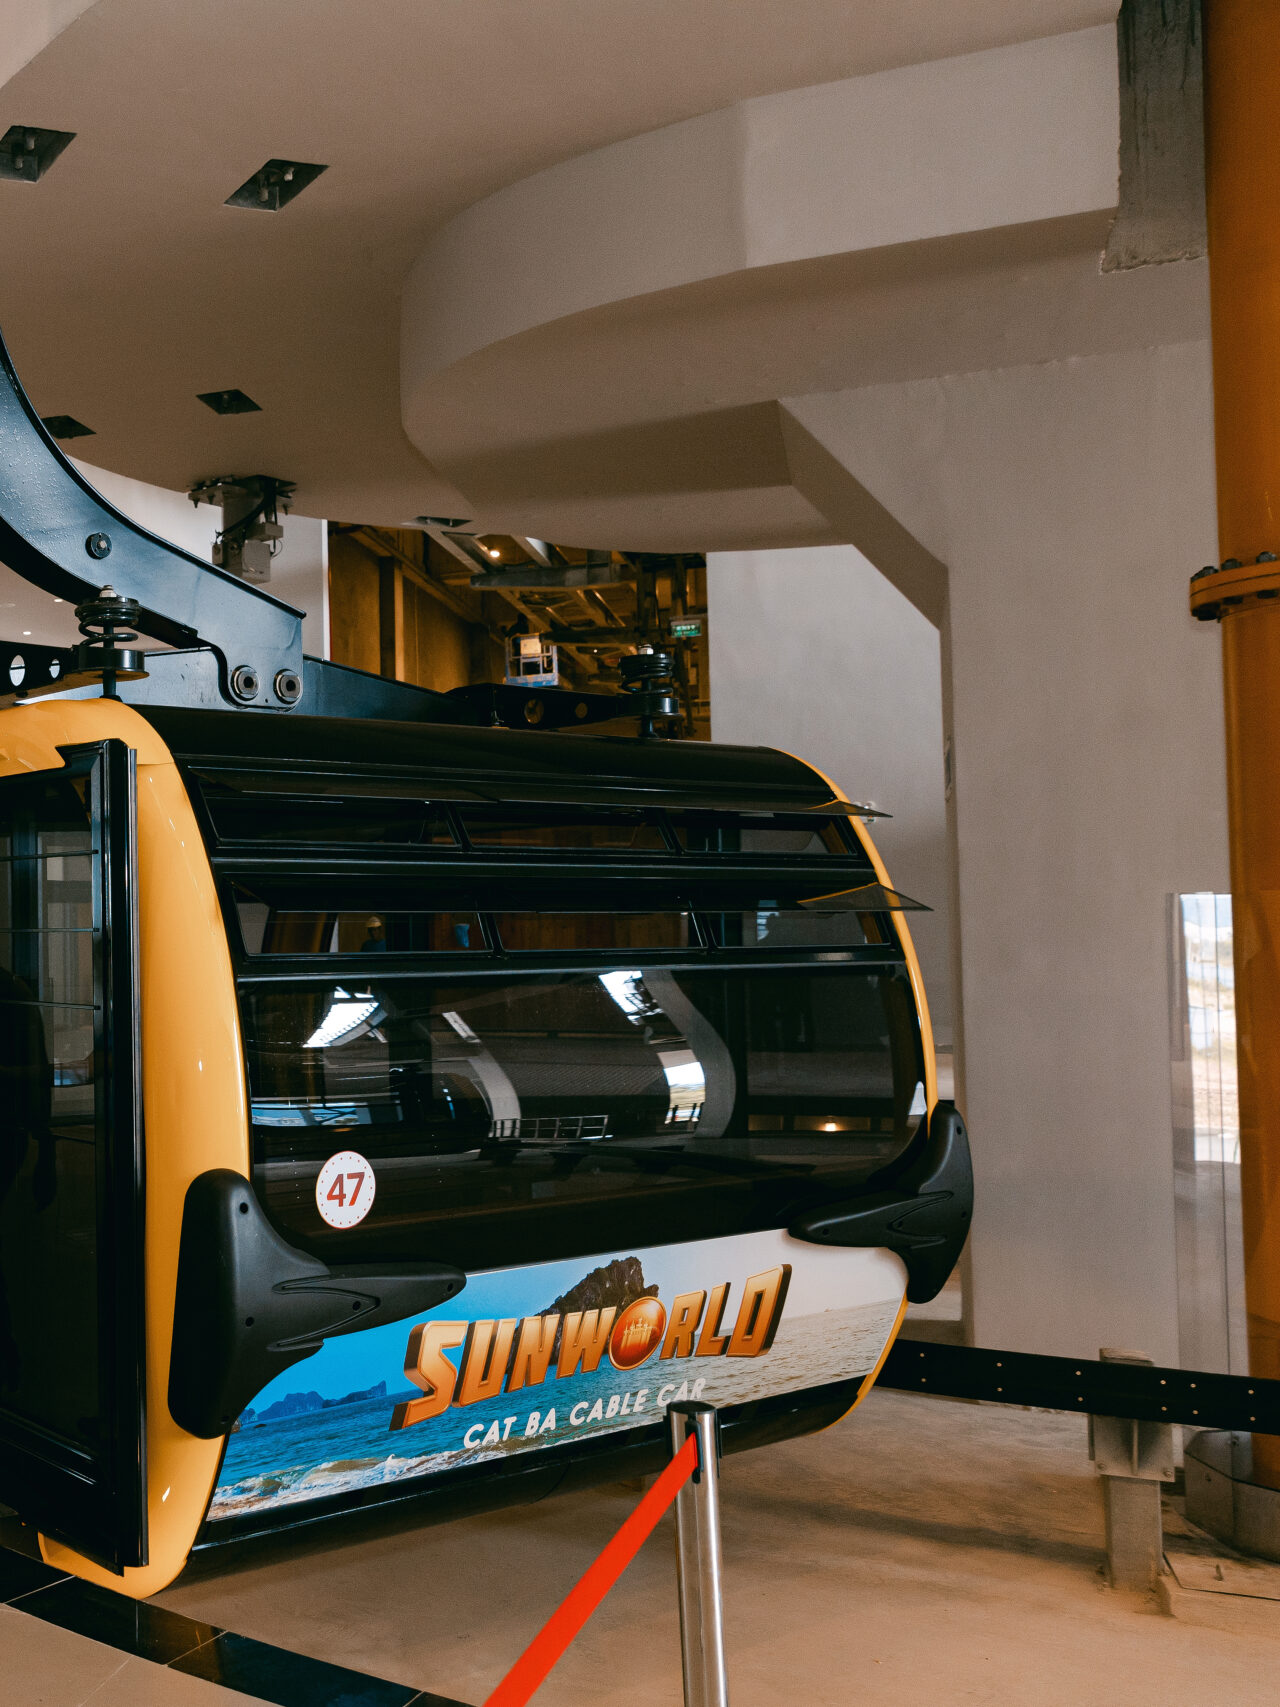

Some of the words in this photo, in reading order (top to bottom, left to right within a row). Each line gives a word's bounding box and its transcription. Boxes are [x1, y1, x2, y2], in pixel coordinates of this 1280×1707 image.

[326, 1171, 366, 1208] 47
[463, 1415, 517, 1449] CAT
[524, 1407, 556, 1436] BA
[569, 1388, 649, 1426] CABLE
[657, 1377, 706, 1408] CAR
